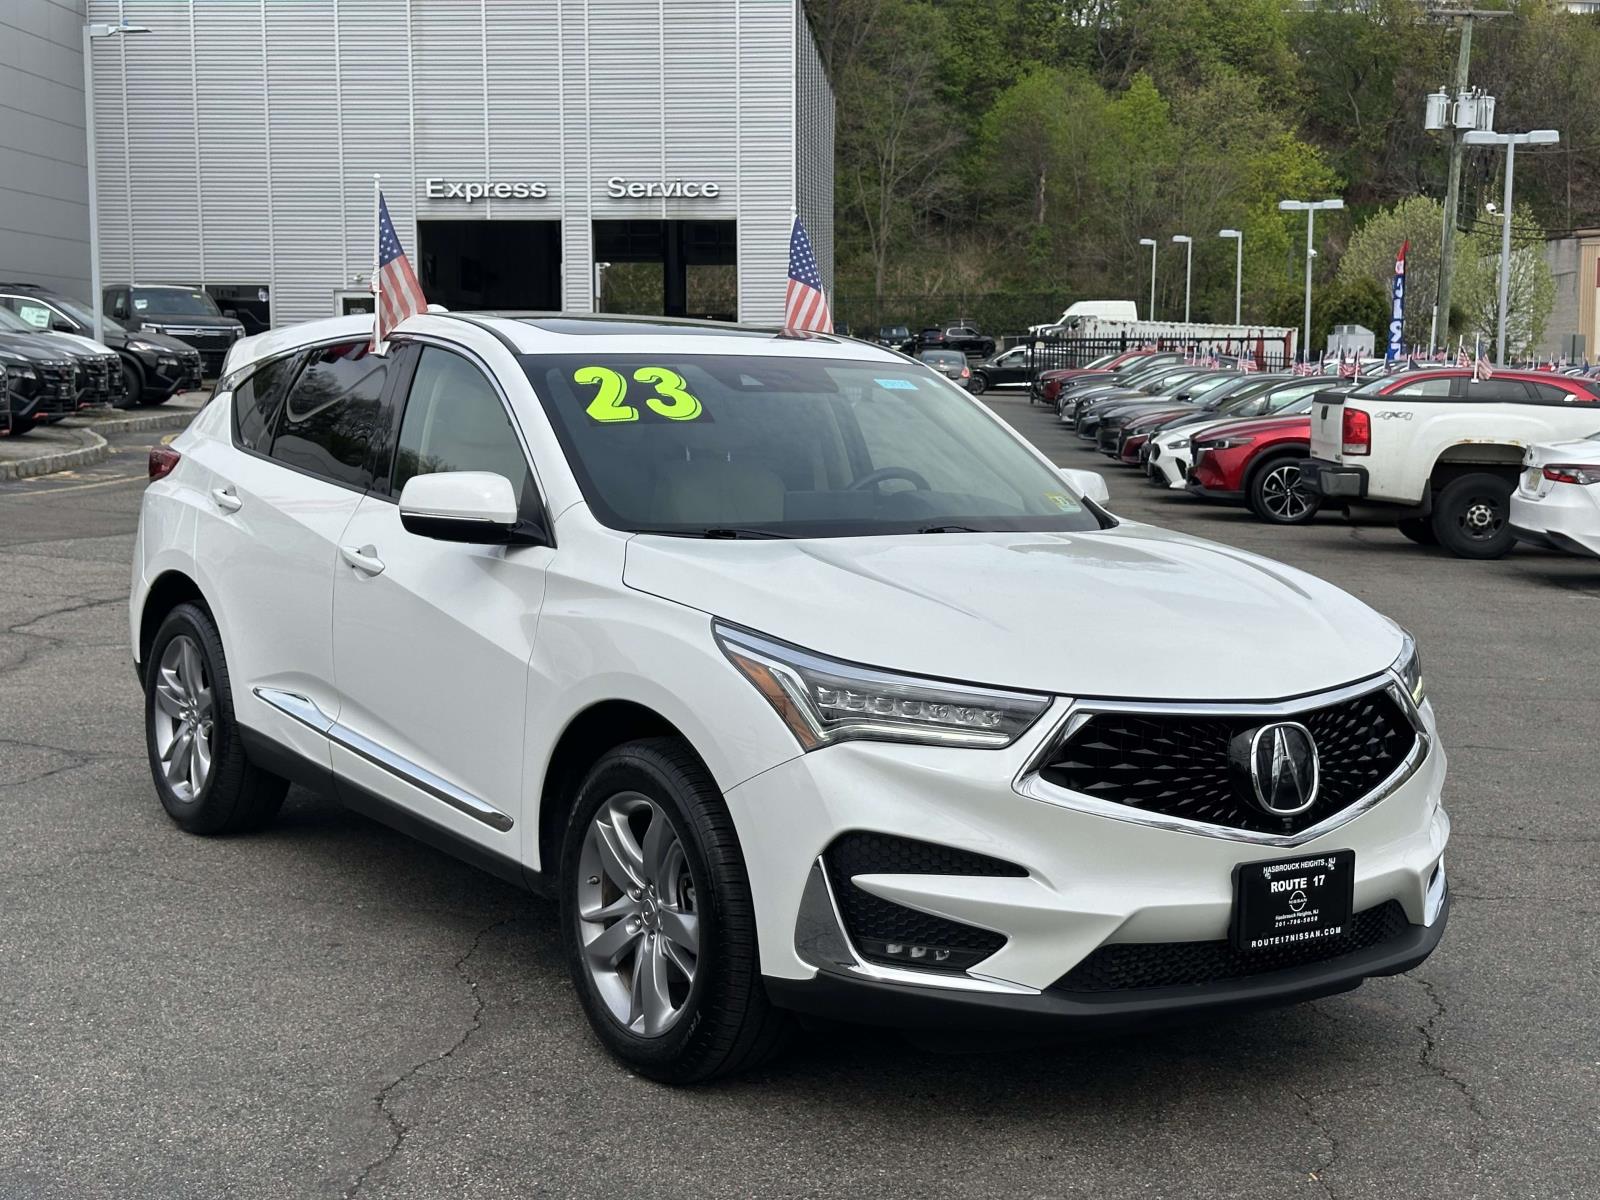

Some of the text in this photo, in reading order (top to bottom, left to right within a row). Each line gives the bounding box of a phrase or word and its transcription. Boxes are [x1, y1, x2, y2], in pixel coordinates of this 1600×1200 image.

[425, 177, 720, 203] Express Service
[574, 366, 703, 423] 23
[1263, 862, 1300, 874] HASBROUCK
[1271, 875, 1326, 893] ROUTE 17
[1251, 926, 1341, 948] ROUTE17NISSAN.COM
